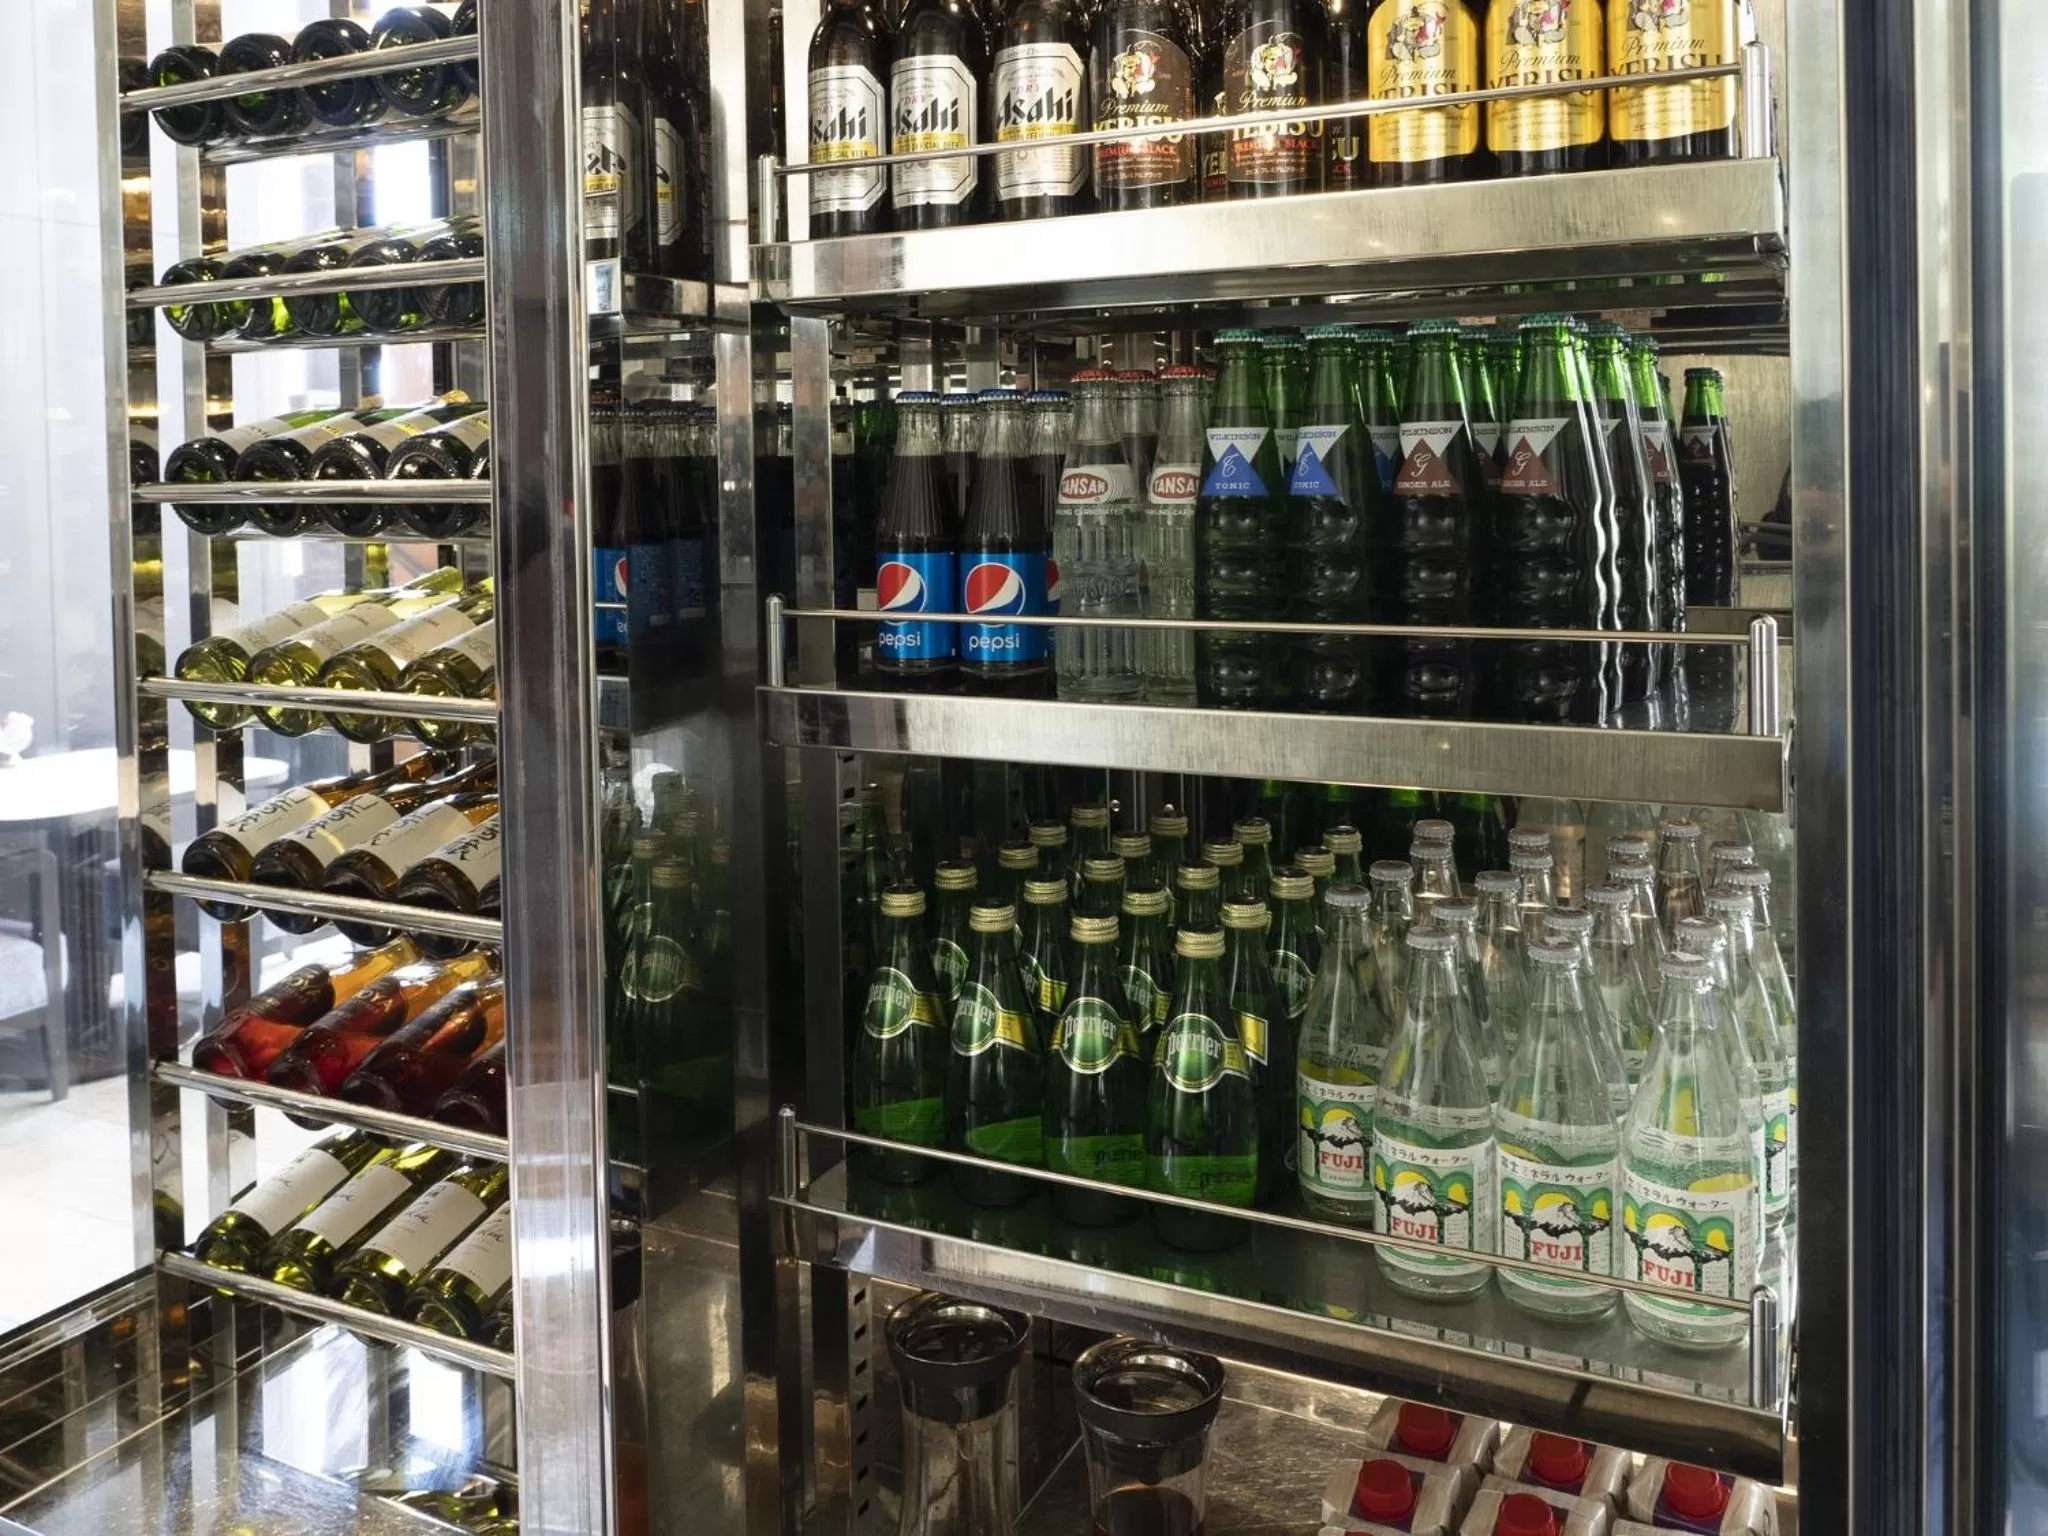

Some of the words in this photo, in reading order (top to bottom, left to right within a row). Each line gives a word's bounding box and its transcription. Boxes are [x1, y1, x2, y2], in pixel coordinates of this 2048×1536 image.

[997, 86, 1073, 128] Asahi
[1100, 97, 1169, 119] Premium
[1215, 481, 1250, 490] TONIC
[879, 631, 921, 649] pepsi
[969, 633, 1020, 652] pepsi
[1064, 1012, 1117, 1050] perrier
[1165, 1029, 1222, 1067] perrier
[1320, 1150, 1364, 1169] FUJI
[1392, 1216, 1437, 1240] FUJI
[1531, 1240, 1582, 1261] FUJI
[1643, 1258, 1694, 1288] FUJI
